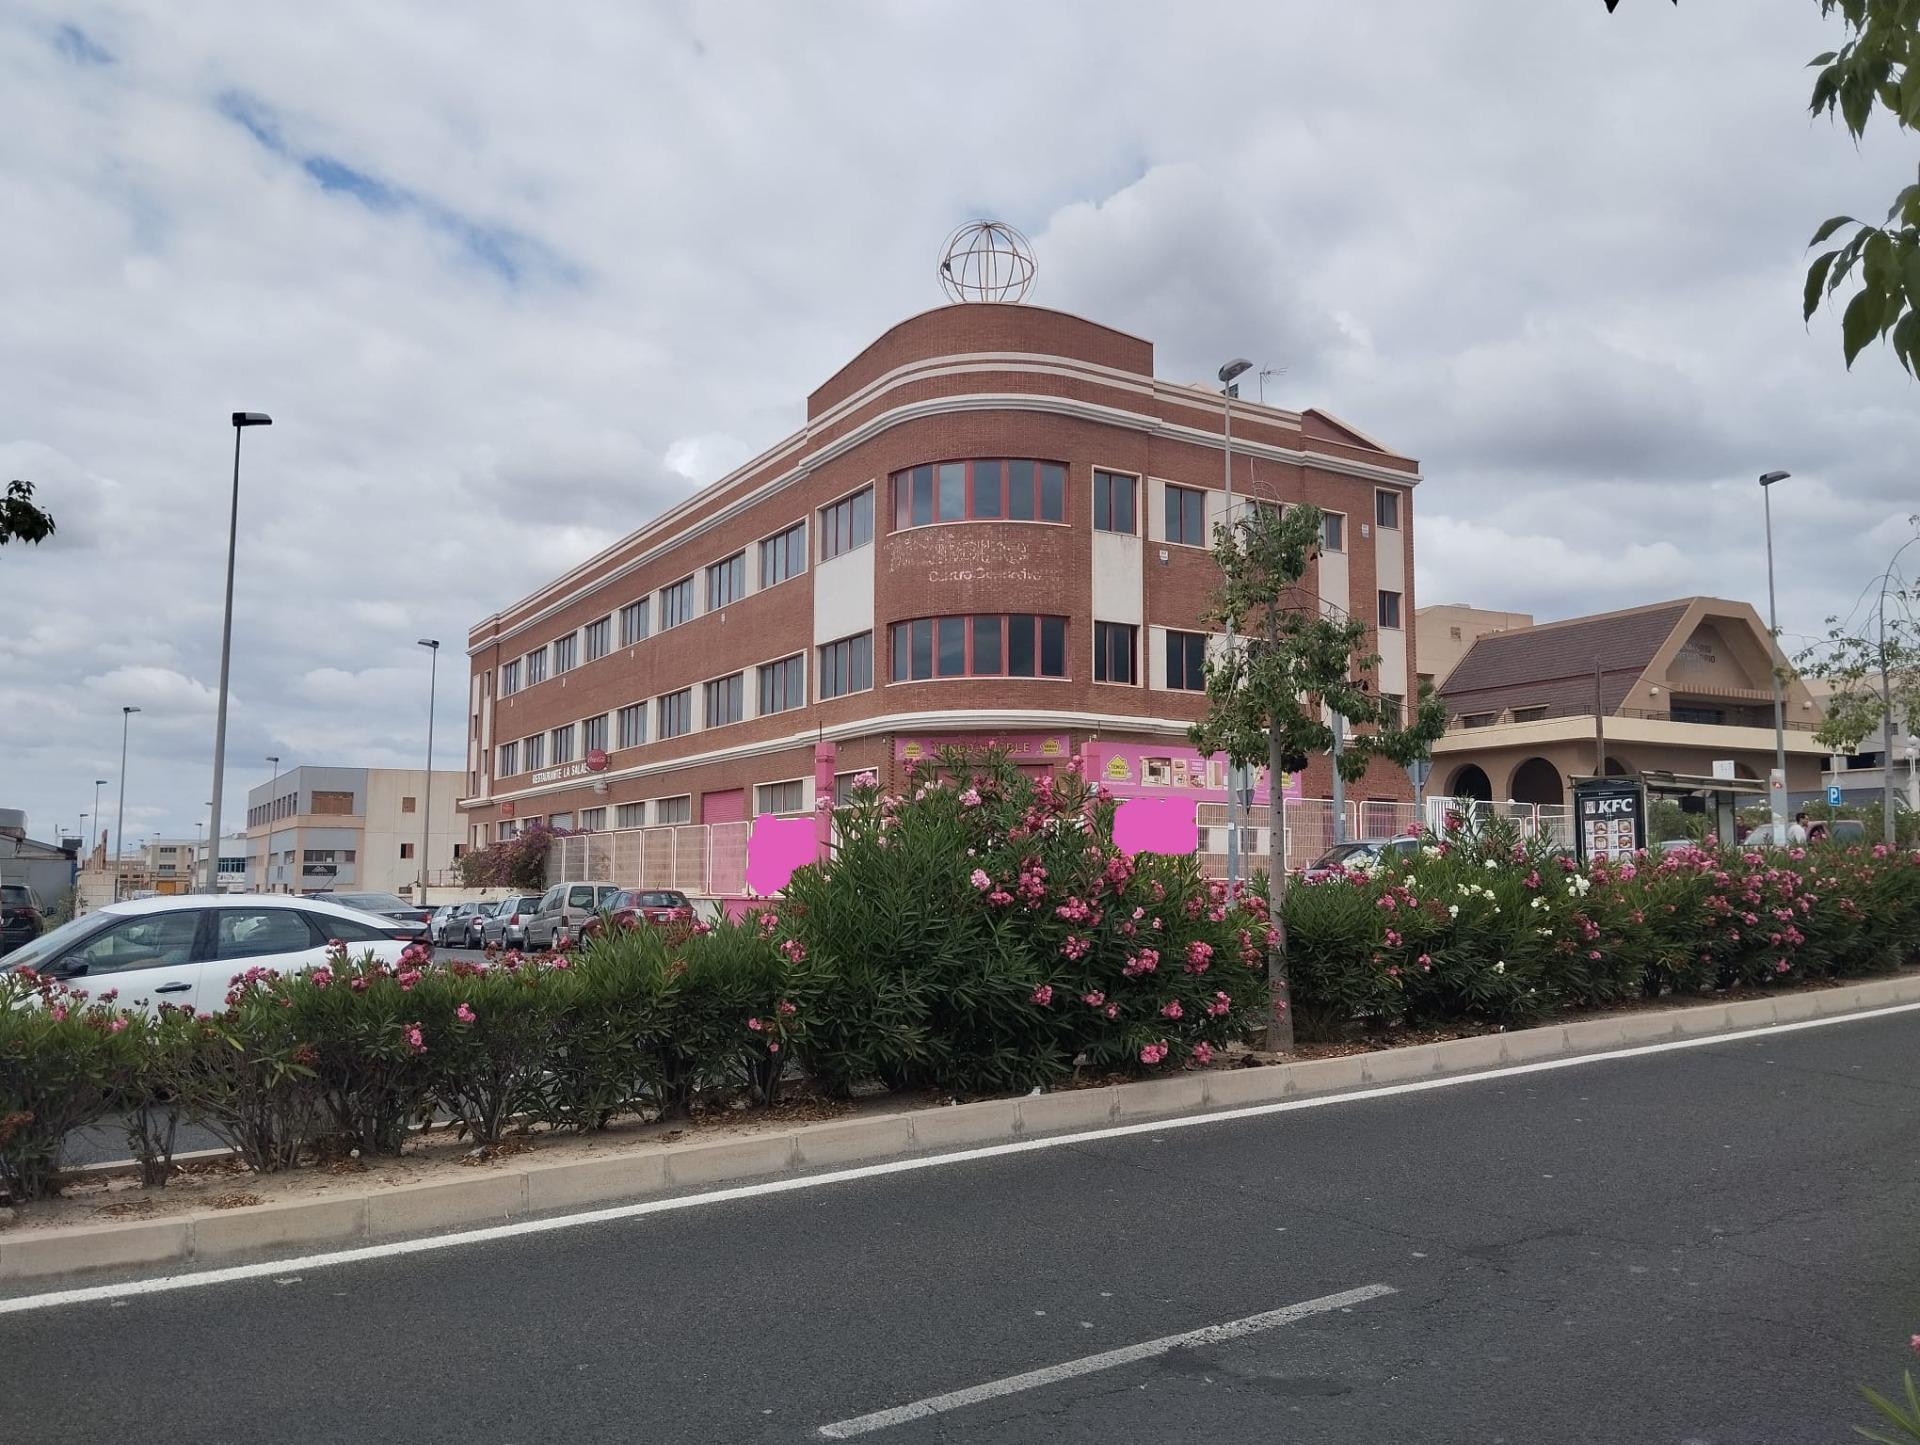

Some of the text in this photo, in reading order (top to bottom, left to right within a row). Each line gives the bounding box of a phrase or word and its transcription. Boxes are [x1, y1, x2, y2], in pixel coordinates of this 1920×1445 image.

[564, 767, 570, 778] LA
[1830, 790, 1838, 804] P
[1598, 798, 1633, 813] KFC
